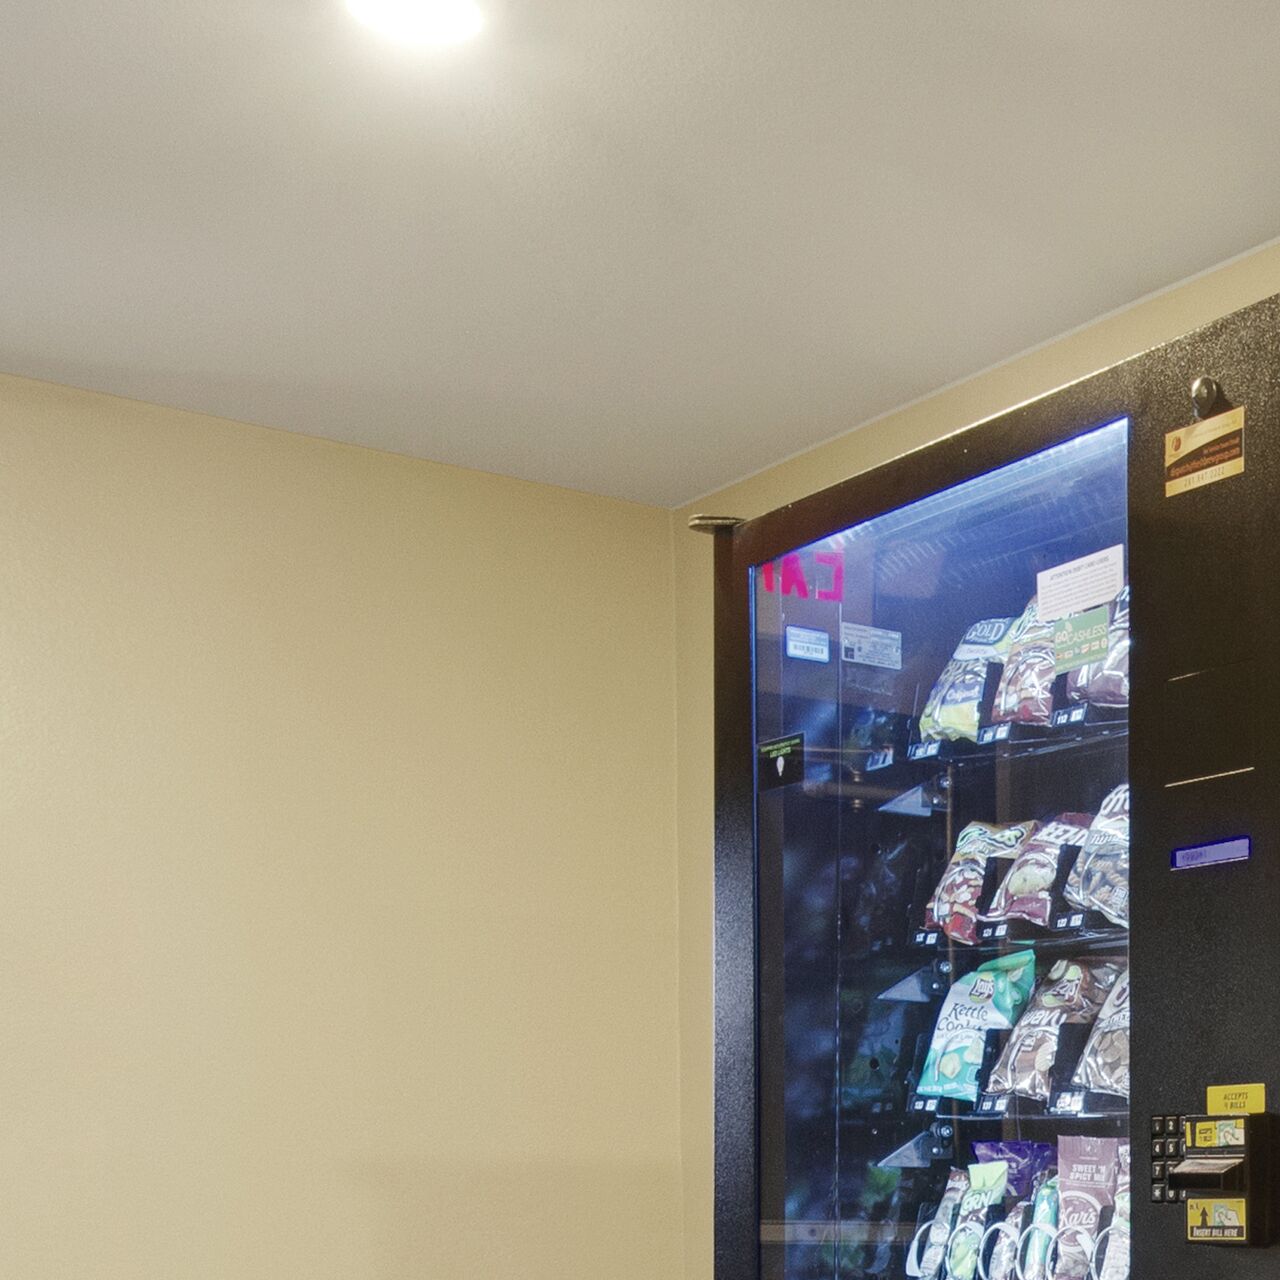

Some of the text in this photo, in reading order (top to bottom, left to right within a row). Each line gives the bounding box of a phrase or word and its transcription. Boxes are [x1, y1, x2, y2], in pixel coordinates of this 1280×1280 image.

[967, 619, 1004, 641] GOLD
[948, 1002, 988, 1021] Kettle
[1224, 1092, 1248, 1101] ACCEPTS
[1168, 1121, 1174, 1130] 2
[1155, 1144, 1174, 1153] 4 5
[1072, 1164, 1096, 1174] SWEET
[1155, 1167, 1160, 1175] 7
[1069, 1172, 1092, 1181] SPICY
[1060, 1207, 1097, 1228] Kar's
[1193, 1227, 1239, 1237] INSERT BILL HERE
